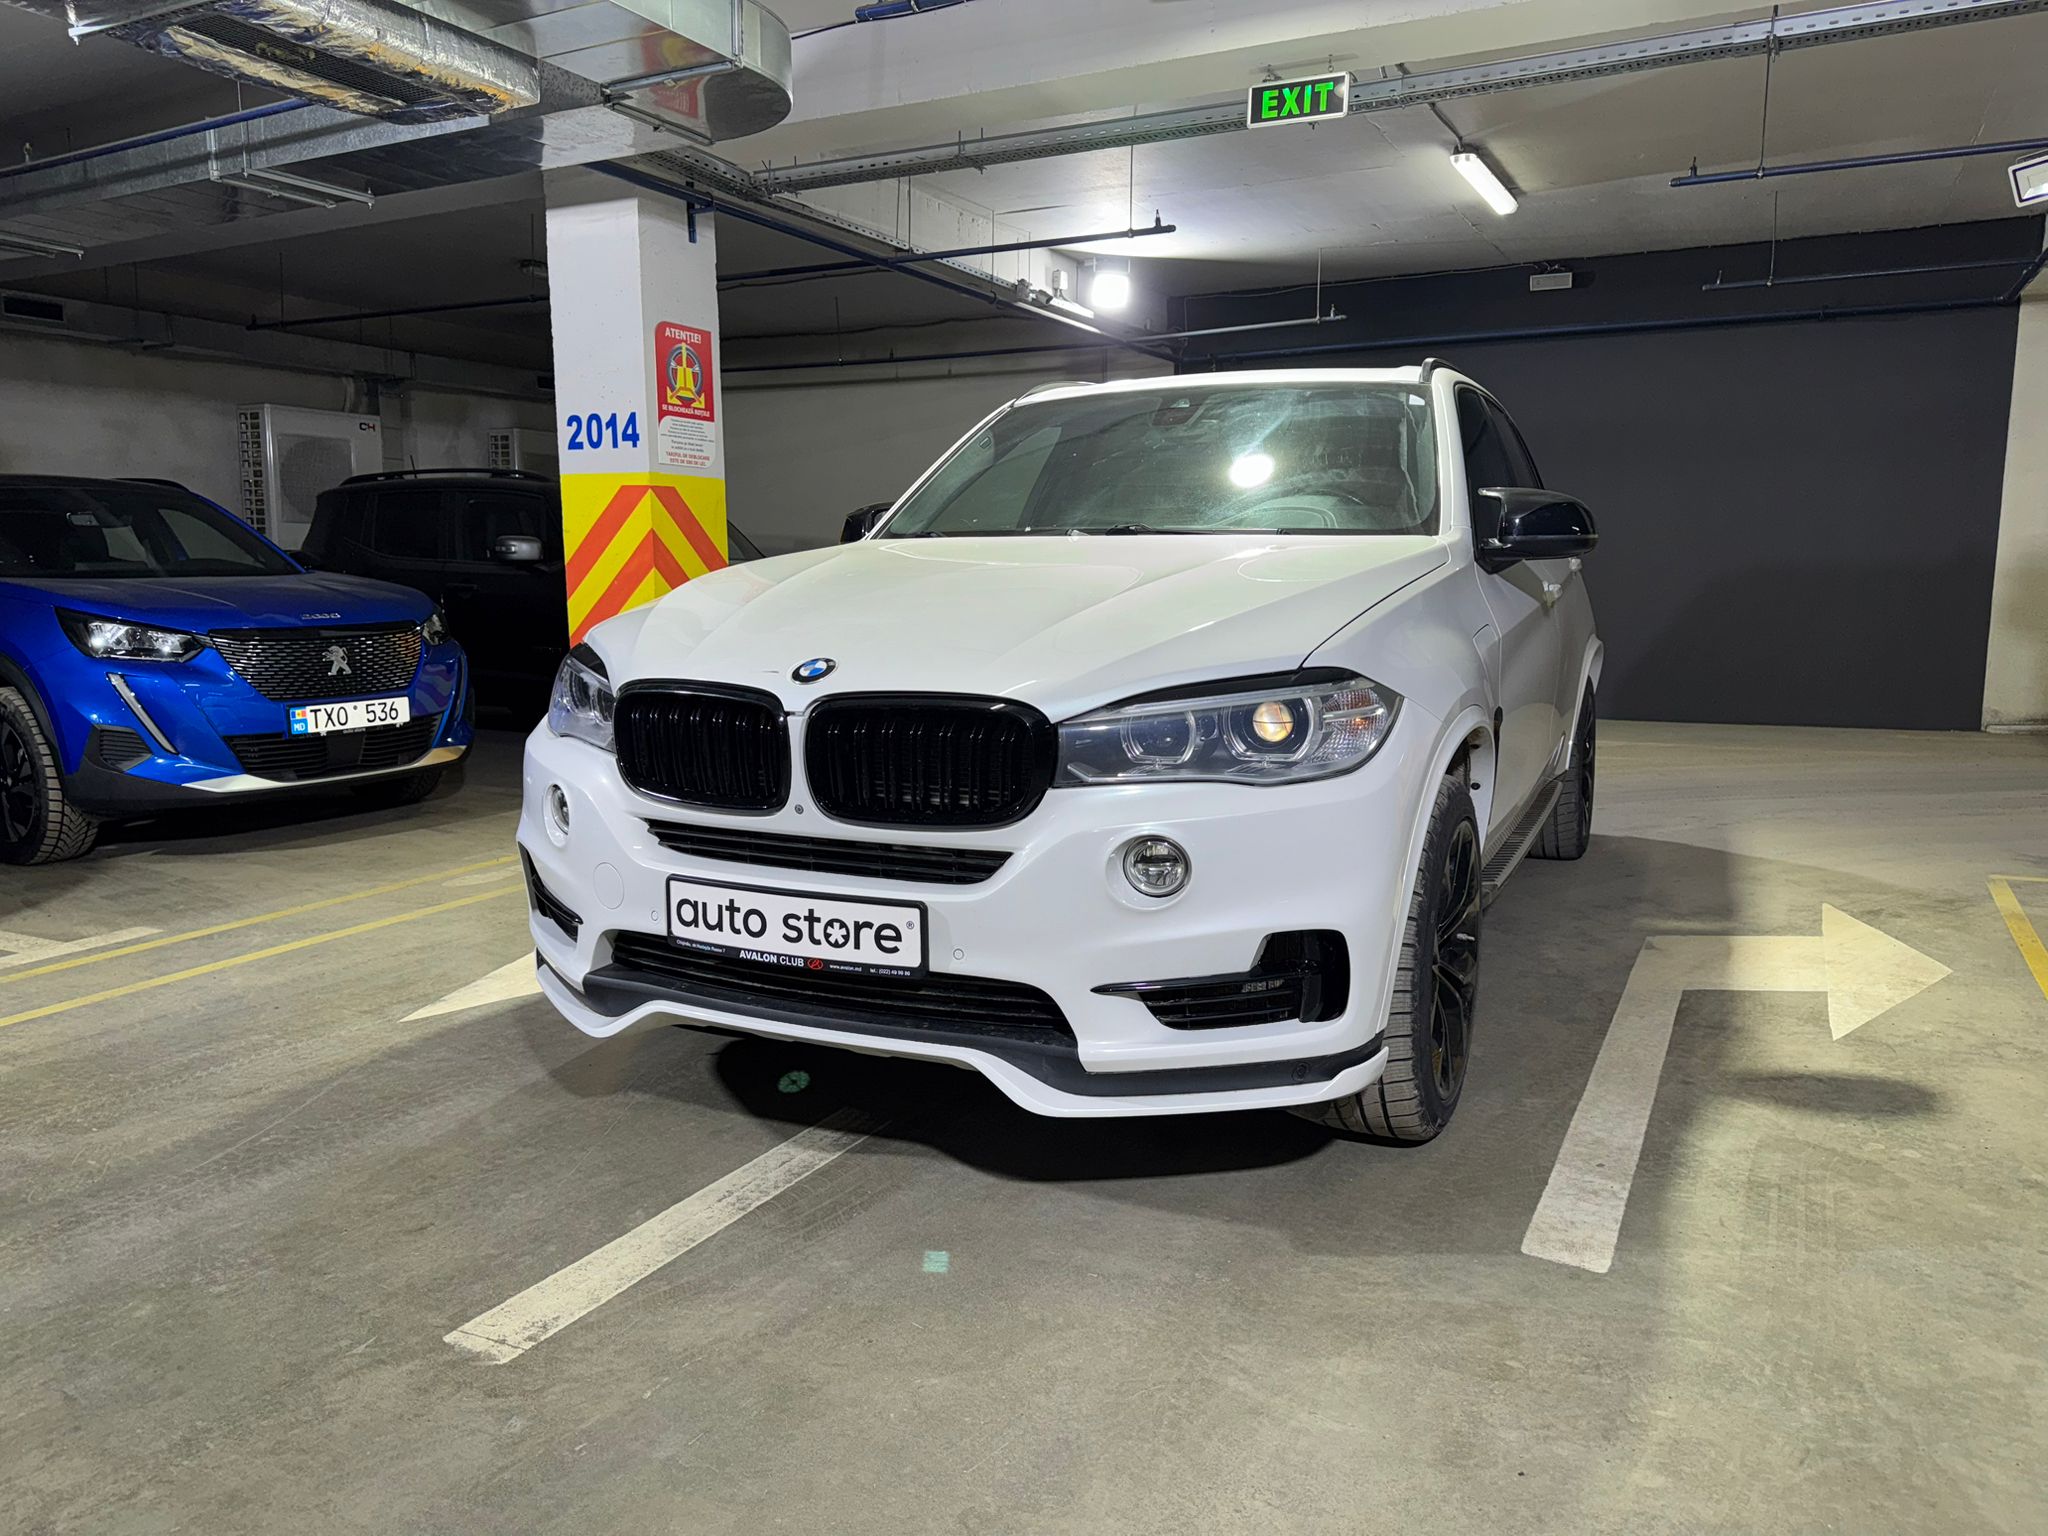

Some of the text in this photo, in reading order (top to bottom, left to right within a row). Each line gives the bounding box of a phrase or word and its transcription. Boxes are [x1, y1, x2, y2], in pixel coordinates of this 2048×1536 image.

[1261, 82, 1334, 118] EXIT
[566, 411, 640, 450] 2014
[365, 701, 399, 723] 536
[293, 723, 306, 732] MD
[676, 898, 767, 938] auto
[782, 908, 903, 954] store
[739, 950, 805, 967] AVALON CLUB
